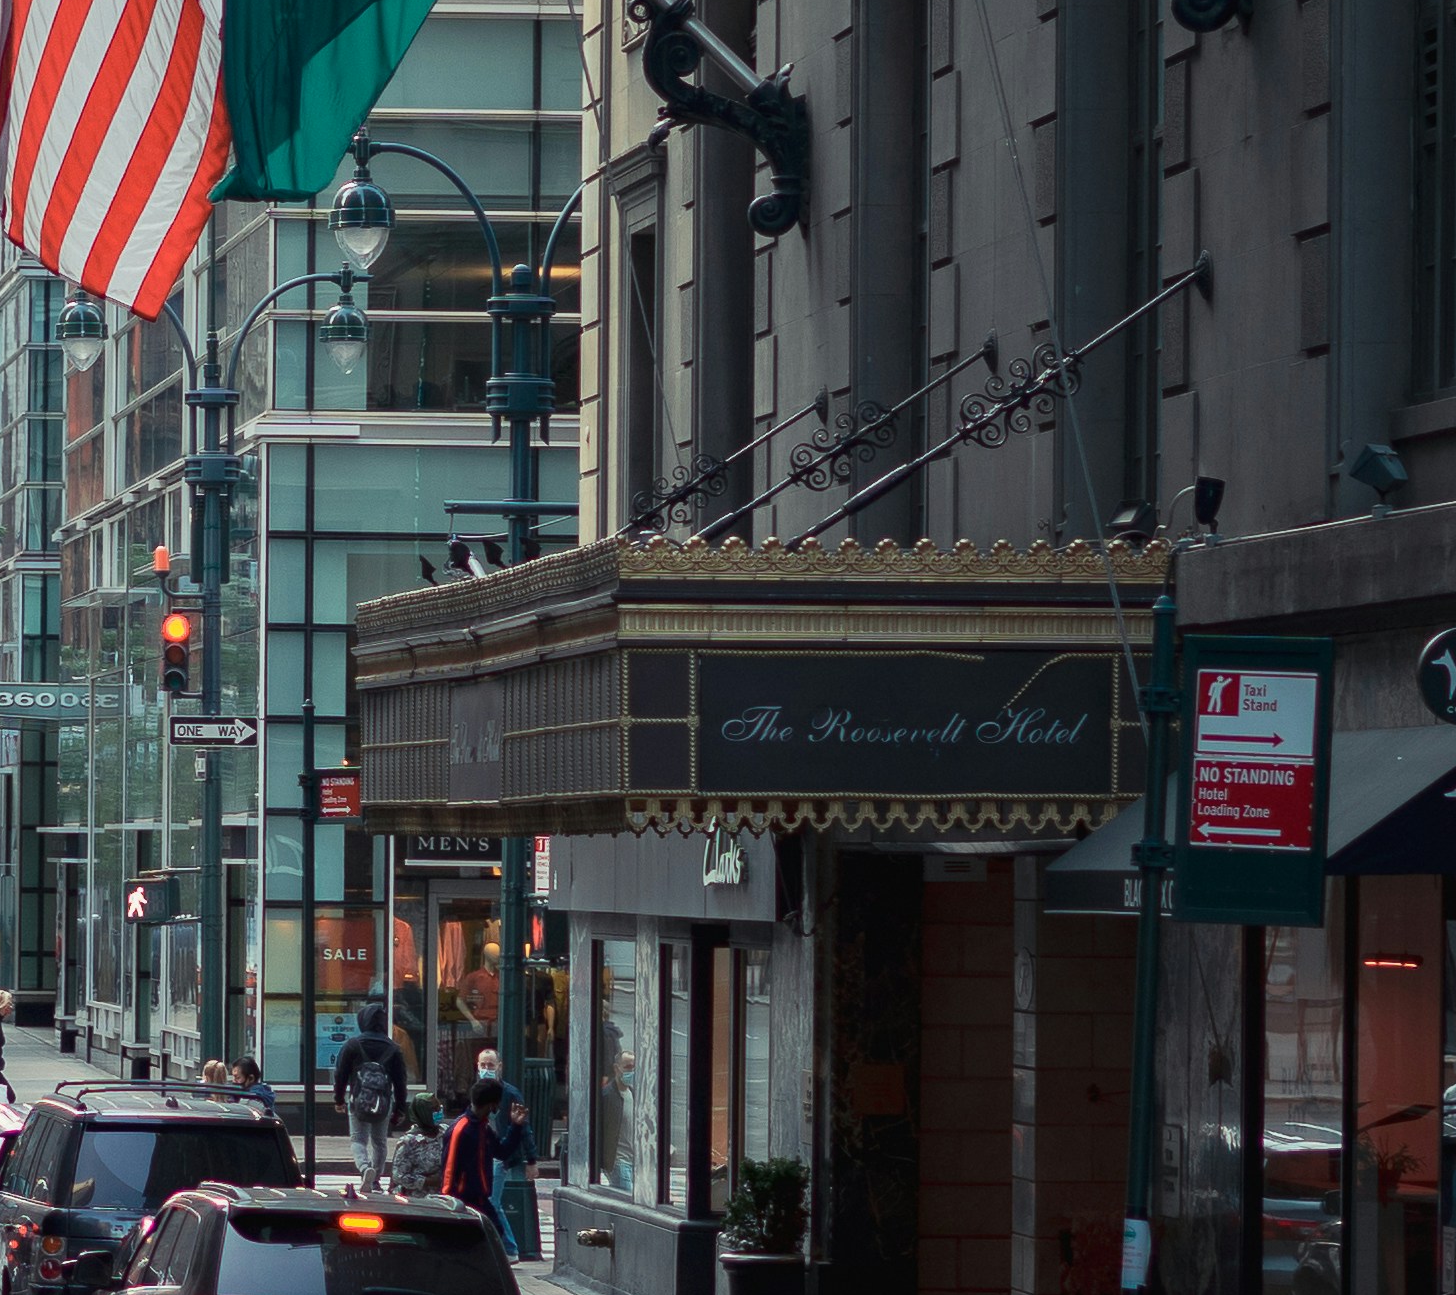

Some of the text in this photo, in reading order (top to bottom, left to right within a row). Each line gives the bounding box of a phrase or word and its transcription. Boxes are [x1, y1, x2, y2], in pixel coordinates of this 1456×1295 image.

[1243, 684, 1267, 697] Taxi
[1242, 698, 1278, 712] Stand
[176, 725, 246, 737] ONE WAY
[721, 706, 1089, 745] The Roosevelt Hotel
[1199, 766, 1295, 786] NO STANDING
[1198, 787, 1228, 801] Hotel
[1197, 803, 1270, 819] Loading Zone
[417, 836, 490, 852] MEN'S
[323, 948, 368, 961] SALE
